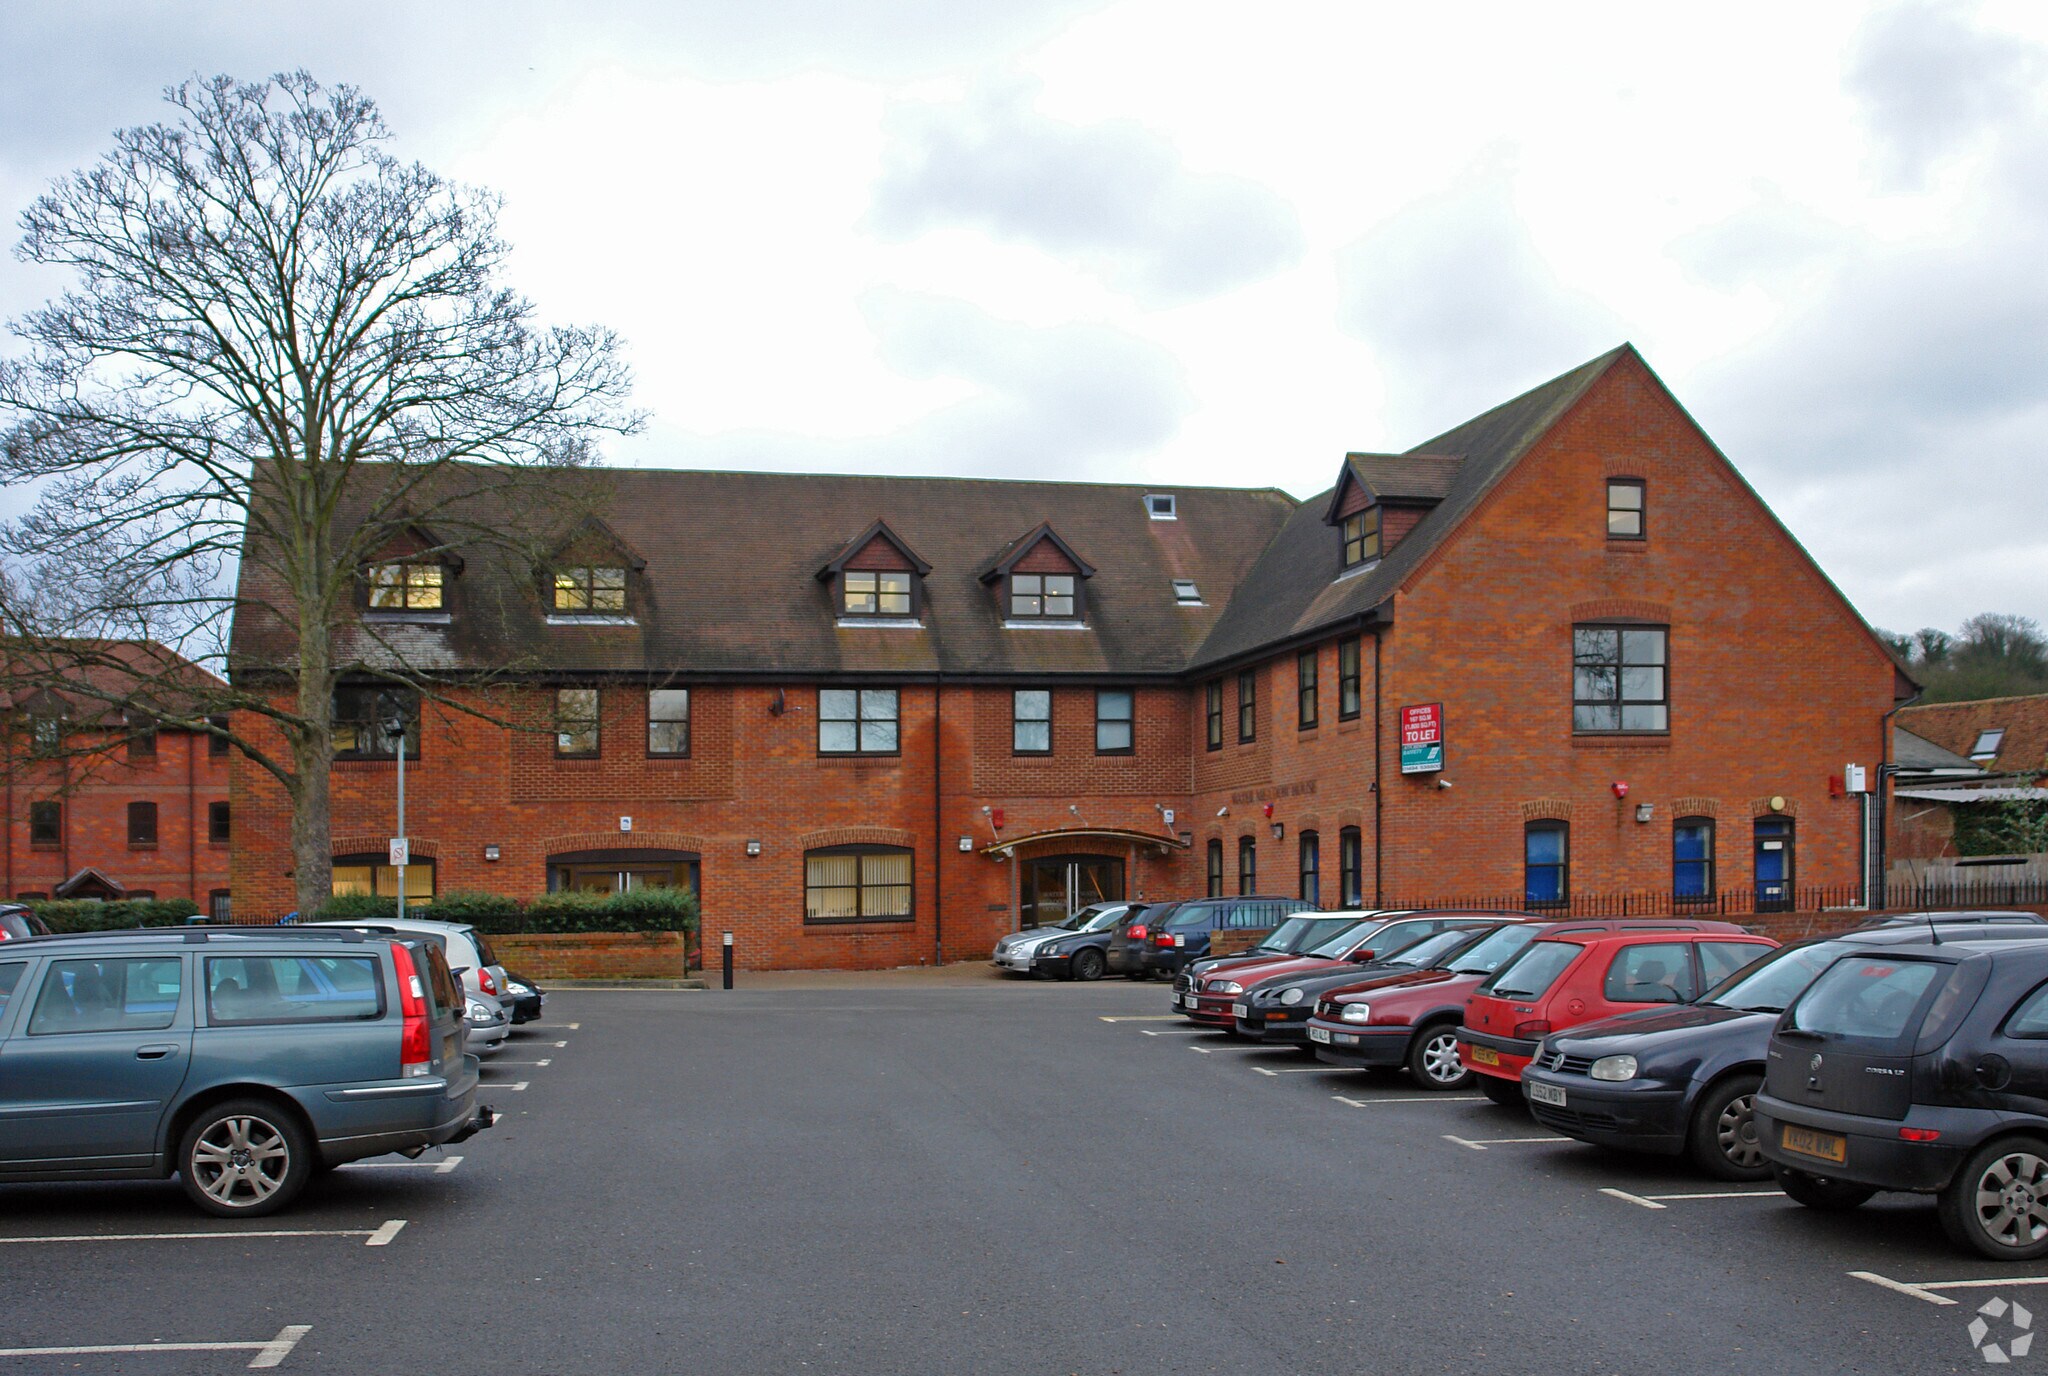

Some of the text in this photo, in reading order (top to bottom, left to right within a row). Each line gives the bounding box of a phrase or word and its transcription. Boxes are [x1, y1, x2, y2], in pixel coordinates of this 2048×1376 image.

[1409, 707, 1432, 716] OFFICES
[1406, 729, 1436, 742] TO LET
[1865, 1066, 1893, 1075] CORSA
